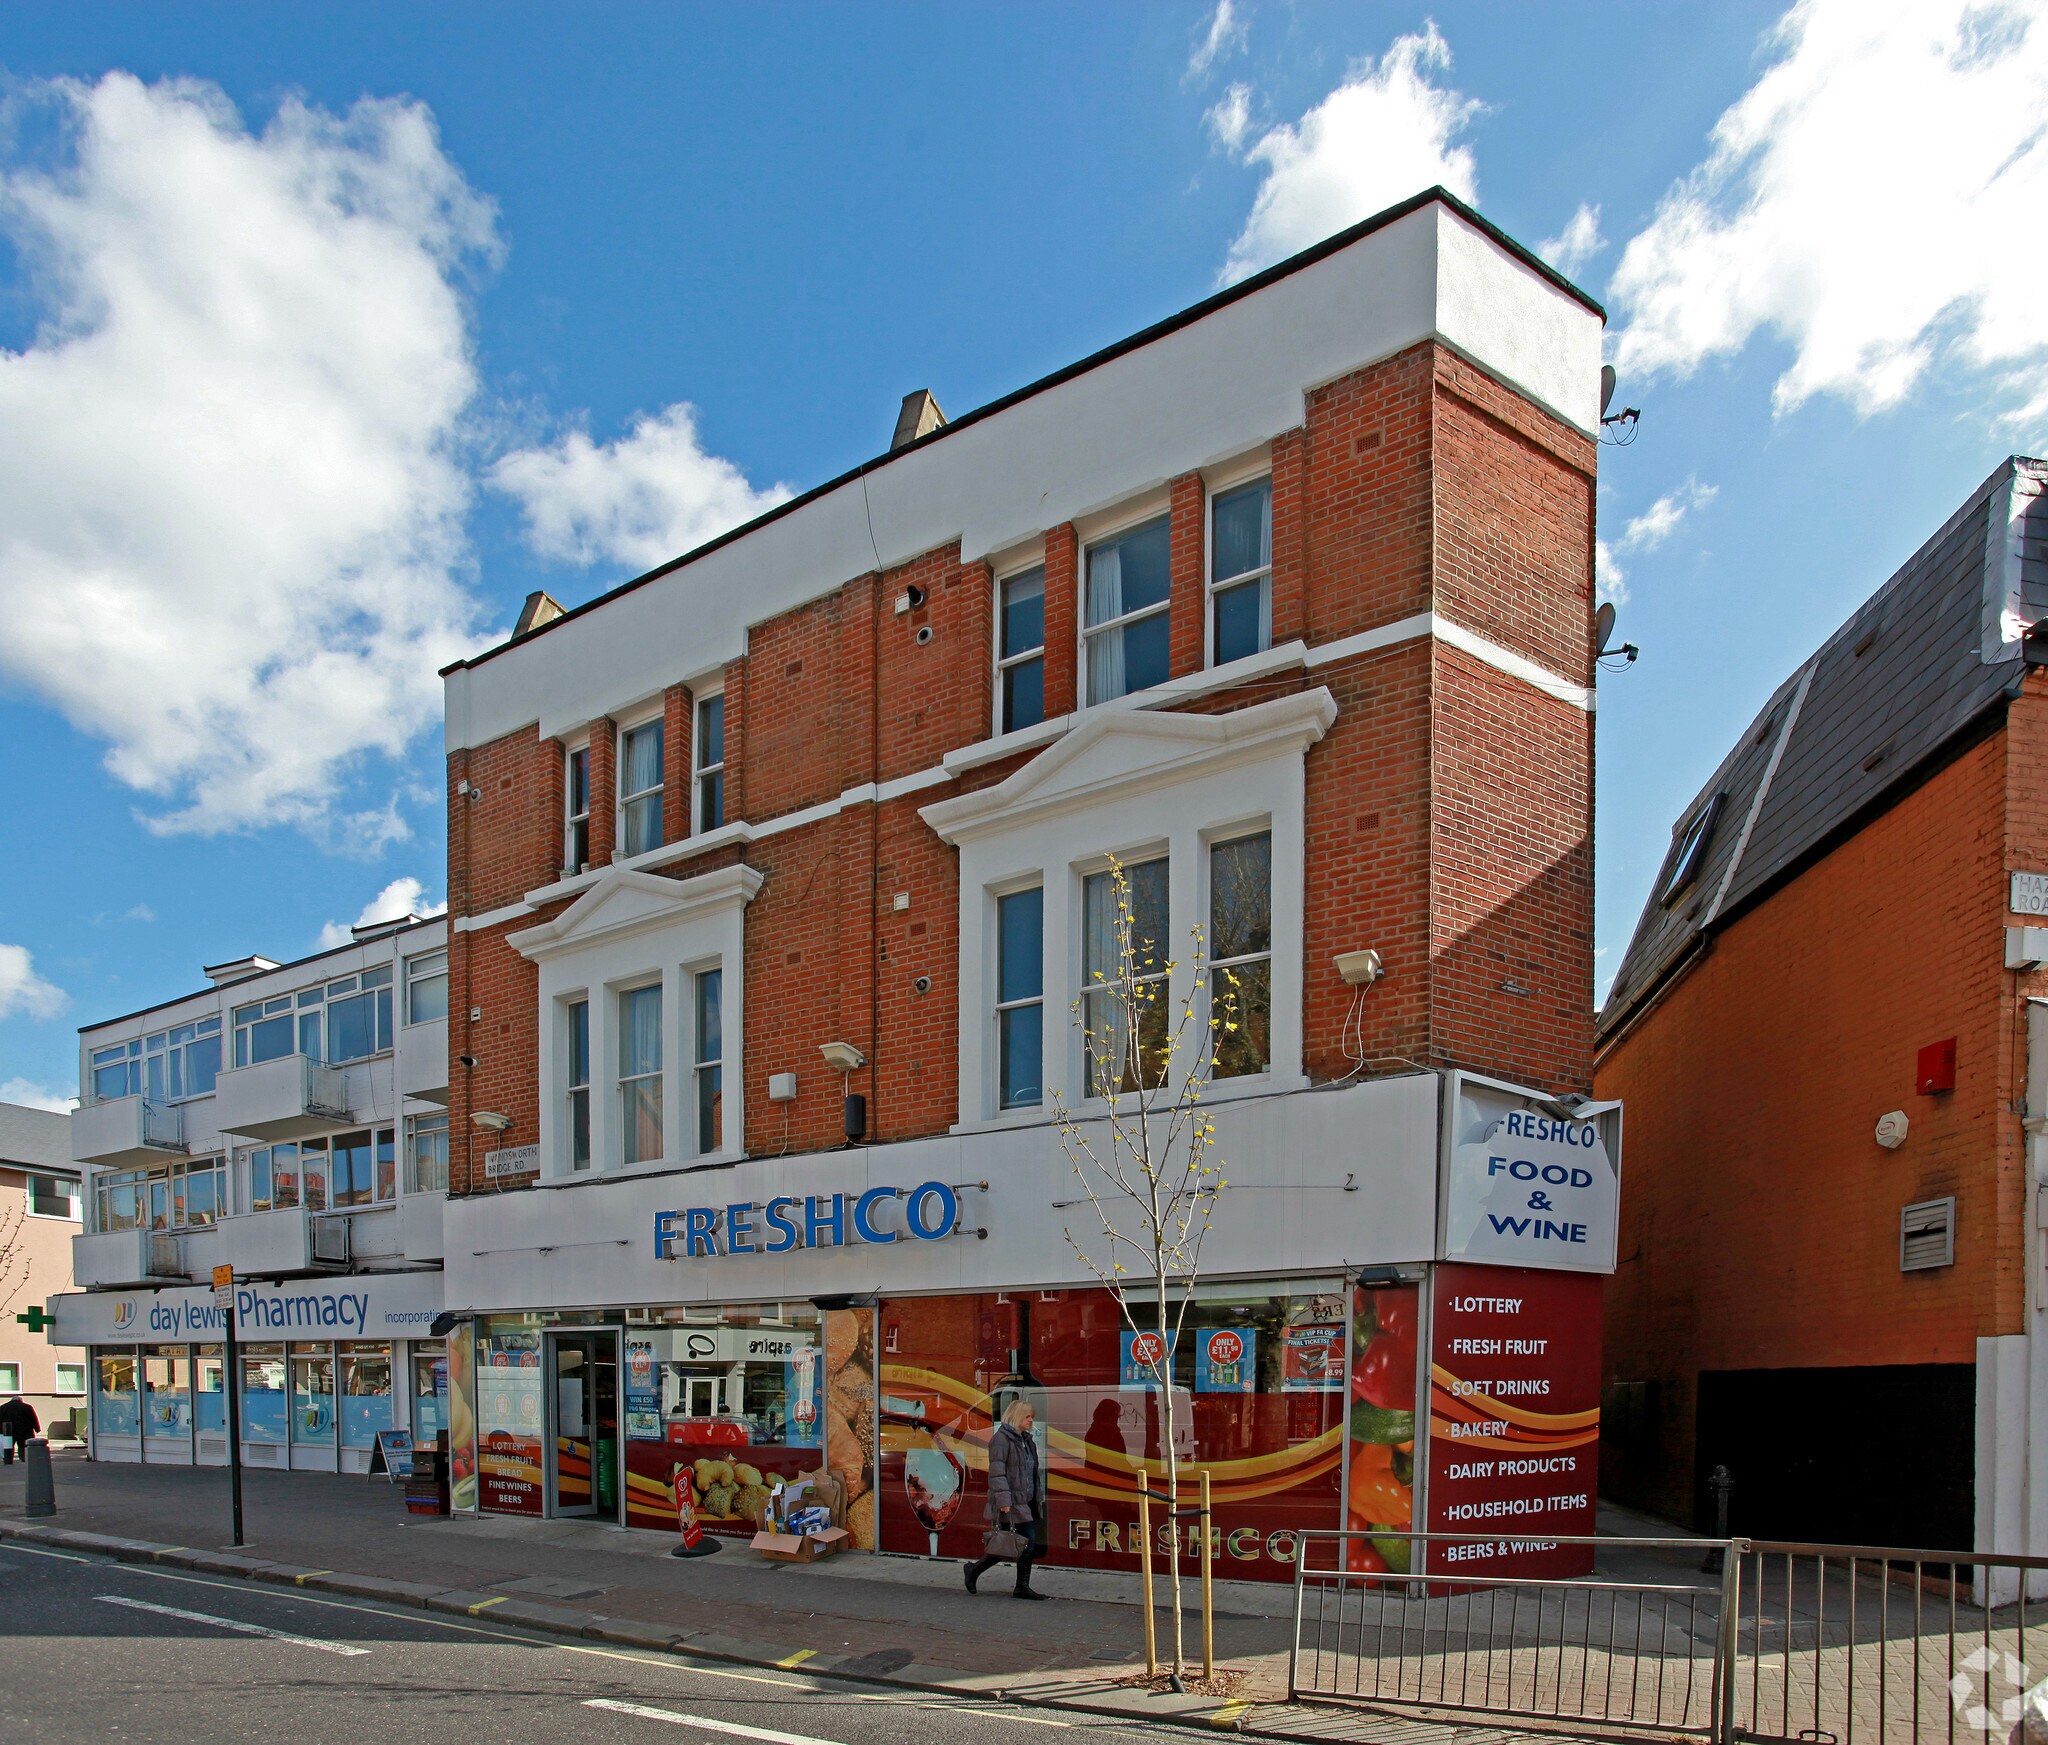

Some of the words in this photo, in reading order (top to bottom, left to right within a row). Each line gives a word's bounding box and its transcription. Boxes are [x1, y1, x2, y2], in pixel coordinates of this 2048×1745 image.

[488, 1162, 511, 1174] BRIDGE
[1487, 1156, 1593, 1188] FOOD
[1527, 1190, 1553, 1211] &
[653, 1180, 961, 1260] FRESHCO
[1487, 1214, 1587, 1243] WINE
[150, 1301, 181, 1337] day
[237, 1289, 369, 1335] Pharmacy
[384, 1308, 441, 1326] incorporatin
[1454, 1296, 1522, 1314] LOTTERY
[1324, 1329, 1337, 1337] CUP
[1211, 1346, 1239, 1355] £11.99
[1216, 1338, 1235, 1346] ONLY
[1453, 1339, 1501, 1354] FRESH
[1505, 1339, 1548, 1354] FRUIT
[1452, 1380, 1492, 1396] SOFT
[1496, 1379, 1550, 1395] DRINKS
[1450, 1421, 1509, 1438] BAKERY
[492, 1441, 526, 1451] LOTTERY
[486, 1454, 509, 1463] FRESH
[511, 1455, 534, 1465] FRUIT
[1449, 1461, 1494, 1480] DAIRY
[1498, 1456, 1576, 1476] PRODUCTS
[497, 1468, 523, 1477] BREAD
[488, 1480, 505, 1489] FINE
[506, 1481, 532, 1492] WINES
[498, 1494, 522, 1504] BEERS
[1448, 1498, 1544, 1521] HOUSEHOLD
[1547, 1494, 1588, 1512] ITEMS
[1069, 1519, 1299, 1563] FRESHCO
[1447, 1542, 1494, 1562] BEERS
[1497, 1541, 1508, 1556] &
